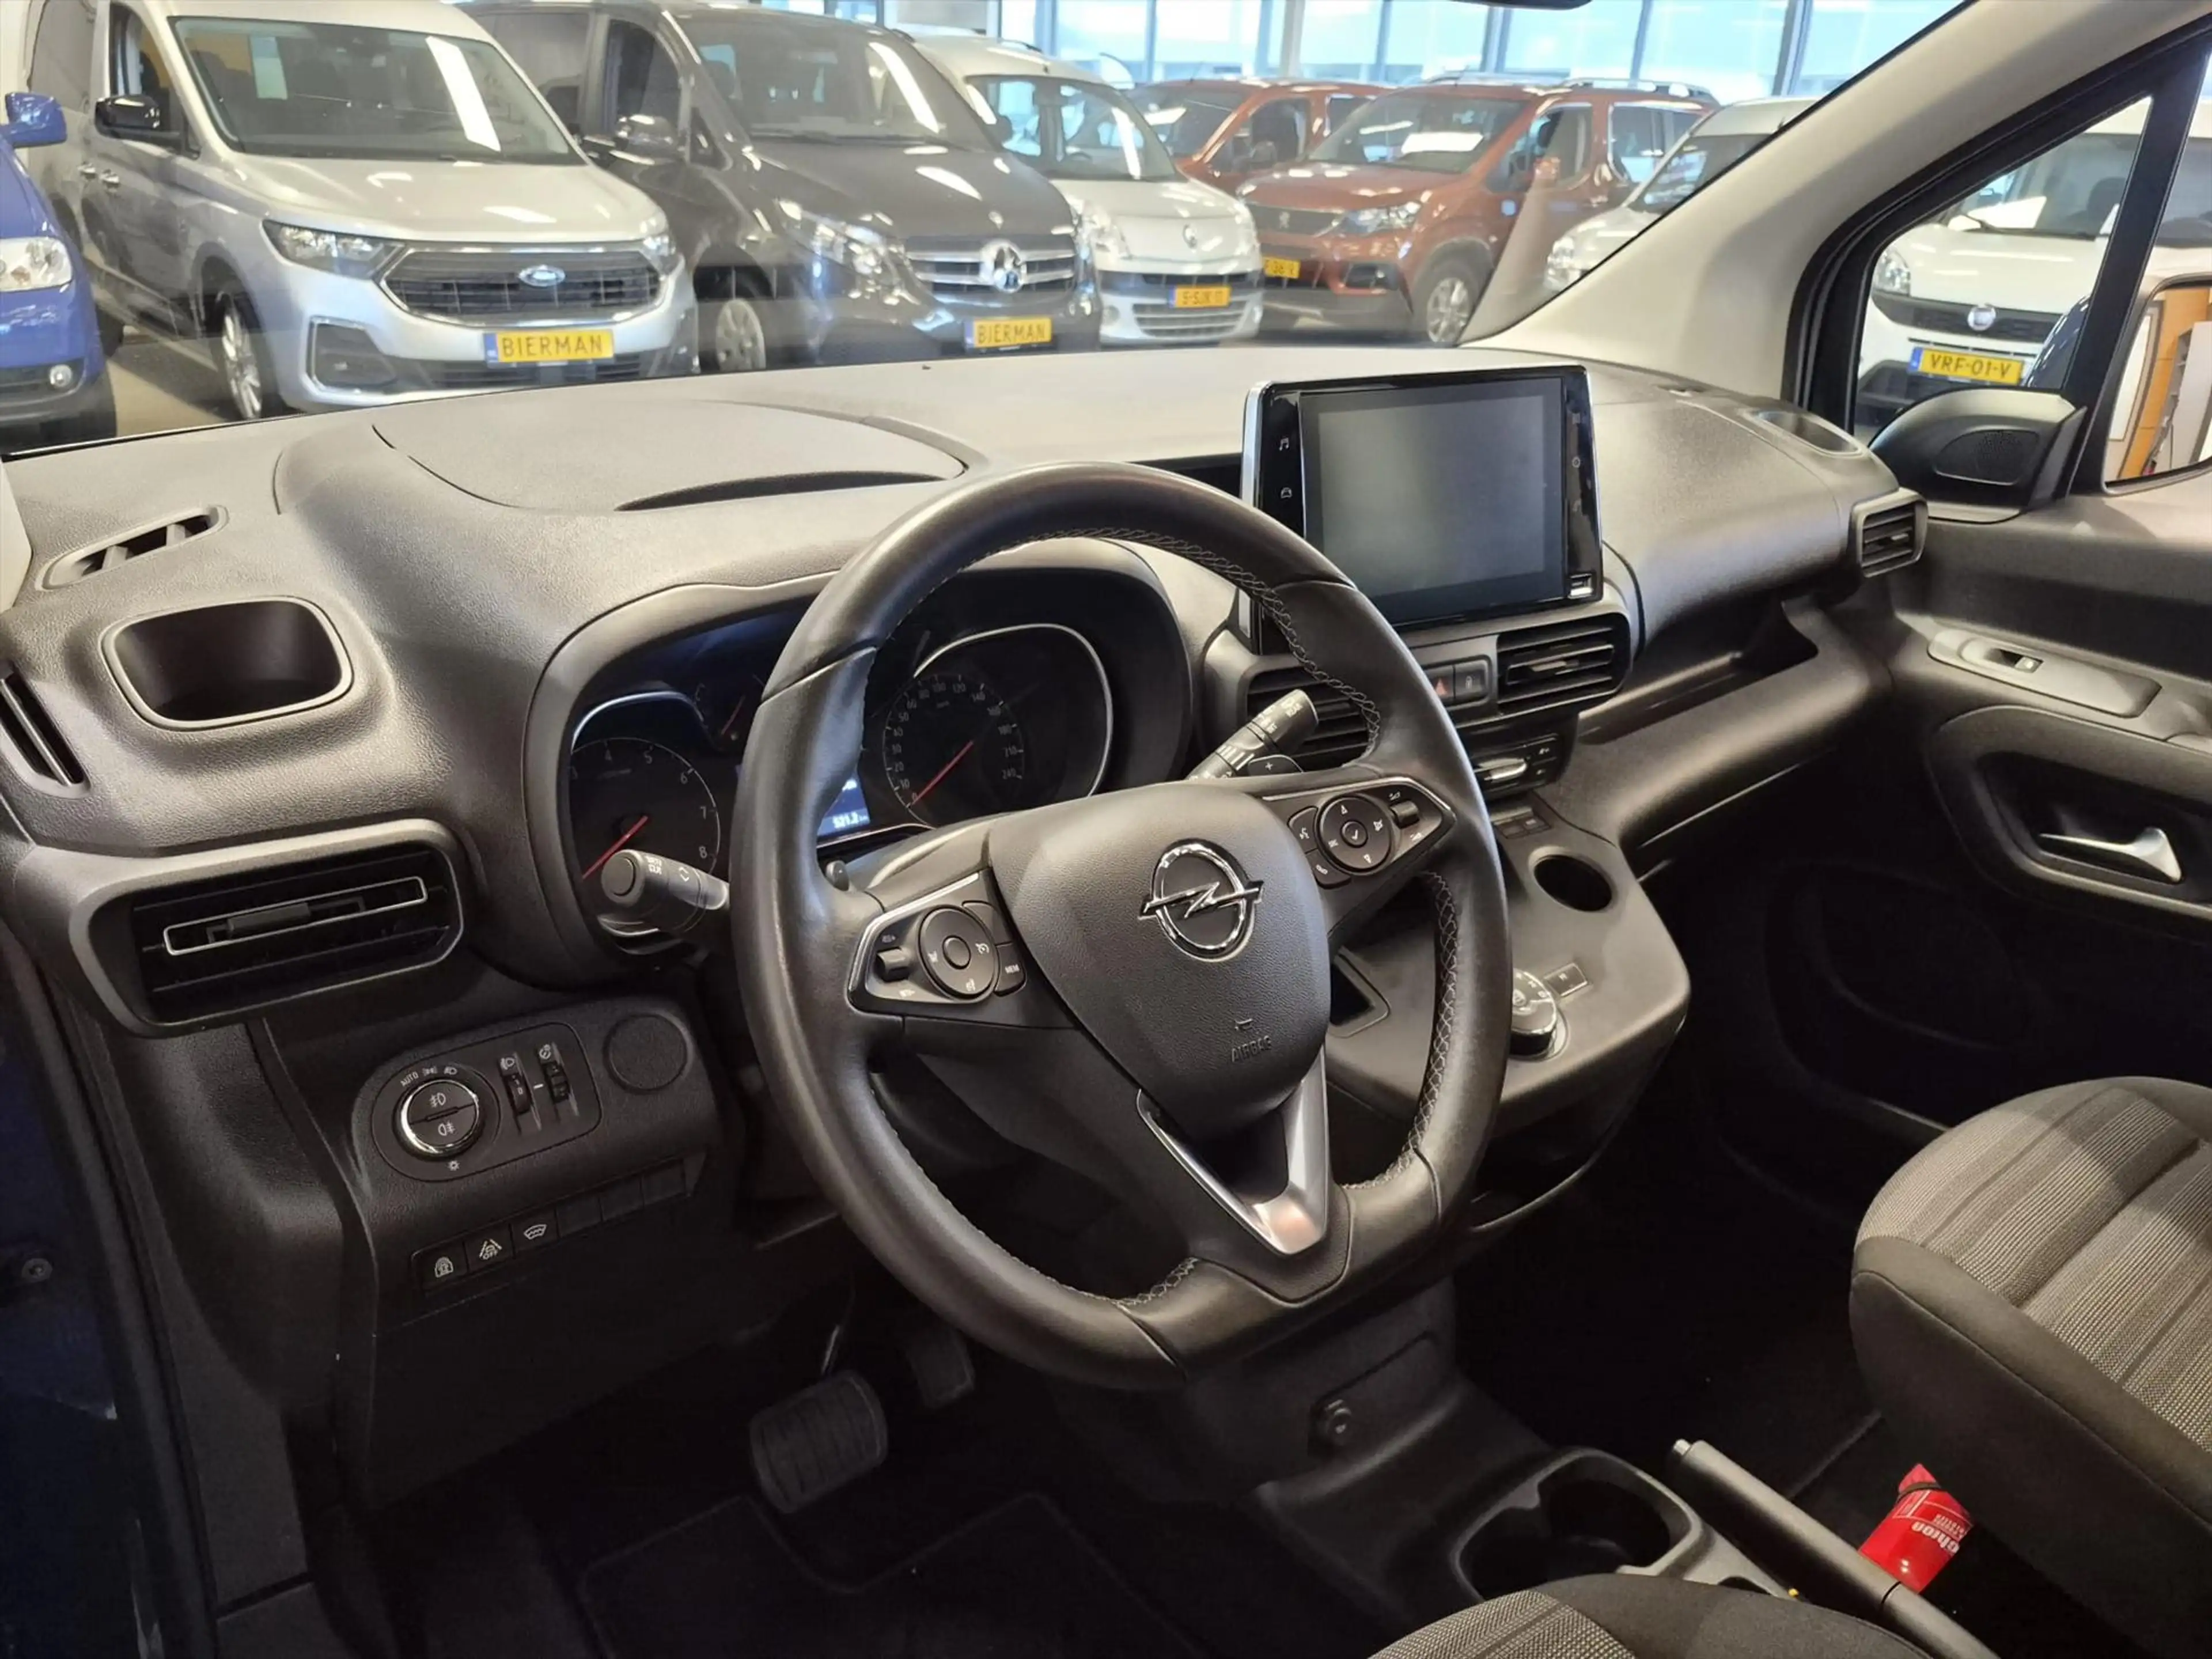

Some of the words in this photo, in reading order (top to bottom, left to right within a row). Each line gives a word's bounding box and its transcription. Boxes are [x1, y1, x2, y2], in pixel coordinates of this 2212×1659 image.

[978, 323, 1046, 344] BIERMAN
[501, 335, 603, 358] BIERMAN
[1930, 353, 2012, 378] VRF-01-V
[644, 751, 653, 764] 5
[680, 772, 688, 784] 6
[699, 846, 707, 859] 8
[400, 1071, 419, 1086] AUTO
